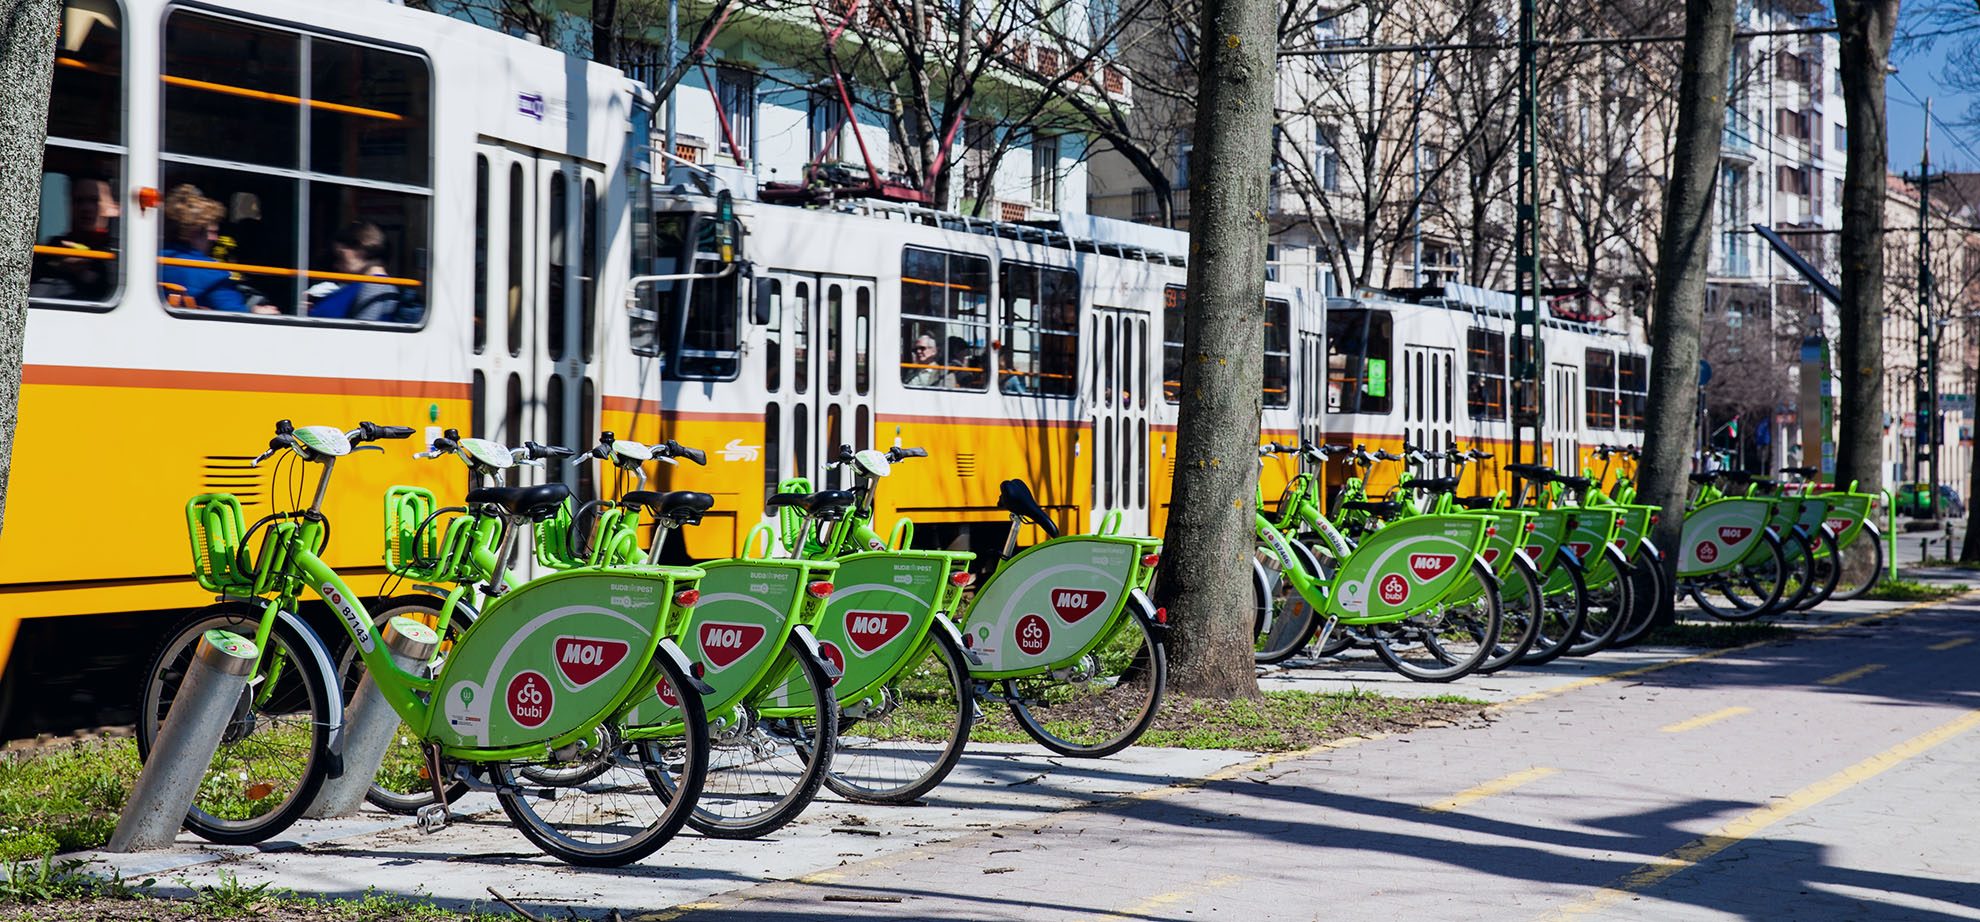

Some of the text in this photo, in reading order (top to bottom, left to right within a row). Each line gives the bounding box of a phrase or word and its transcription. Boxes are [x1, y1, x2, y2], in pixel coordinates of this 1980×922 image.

[1722, 528, 1741, 538] MOL
[1414, 557, 1441, 570] MOL
[1057, 593, 1088, 609] MOL
[1385, 592, 1402, 600] bubi
[342, 606, 369, 643] 87143
[852, 617, 888, 635] MOL
[705, 628, 742, 649] MOL
[1023, 640, 1043, 649] bubi
[562, 643, 603, 666] MOL
[516, 704, 543, 719] bubi
